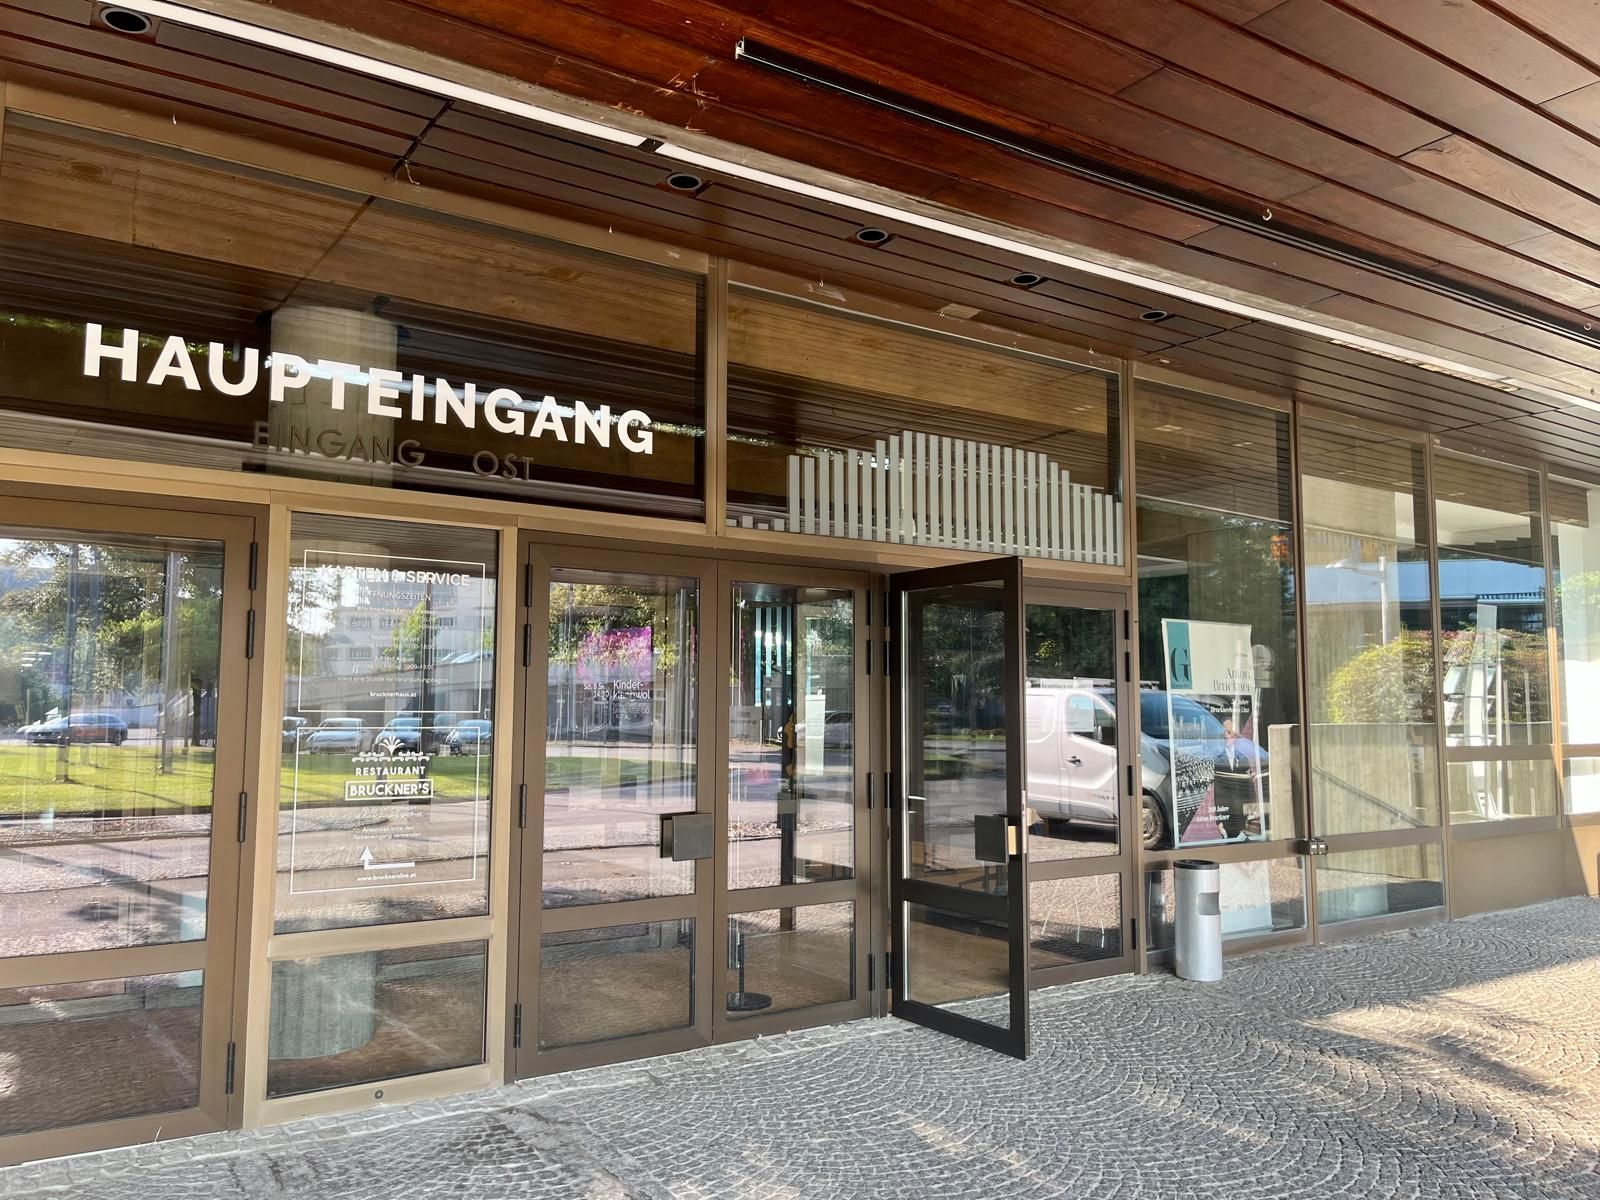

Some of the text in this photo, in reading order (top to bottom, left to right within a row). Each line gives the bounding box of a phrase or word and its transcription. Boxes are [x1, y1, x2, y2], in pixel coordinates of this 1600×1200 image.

[83, 322, 655, 455] HAUPTEINGANG
[252, 420, 535, 481] EINGANG OST
[406, 570, 470, 586] SERVICE
[1170, 647, 1191, 683] G
[613, 679, 644, 690] Kinder-
[369, 690, 417, 698] brucknerhaus.at
[355, 766, 426, 777] RESTAURANT
[350, 782, 430, 797] BRUCKNER'S
